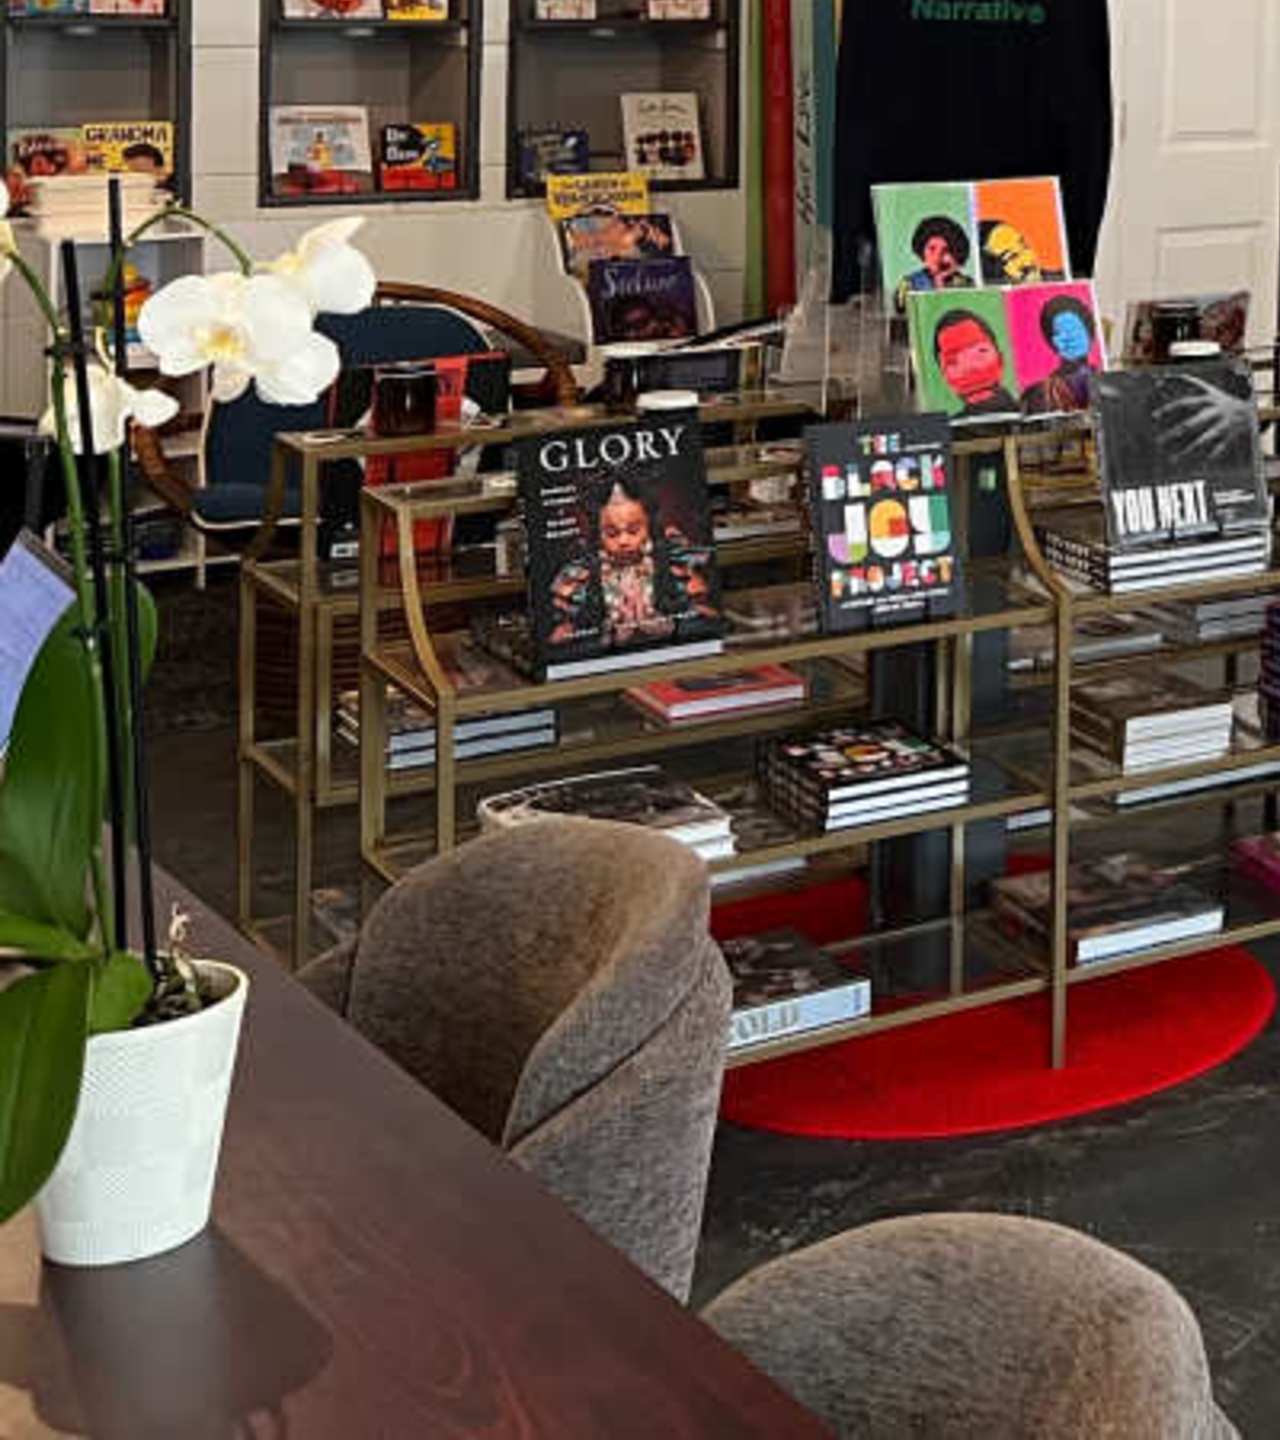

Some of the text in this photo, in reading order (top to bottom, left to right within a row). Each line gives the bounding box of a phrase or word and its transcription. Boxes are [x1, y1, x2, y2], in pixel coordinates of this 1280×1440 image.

[539, 426, 686, 473] GLORY
[821, 453, 948, 502] BLACK
[826, 494, 953, 565] JOY
[1110, 479, 1210, 537] YOU NEXT
[831, 555, 954, 601] PROJECT
